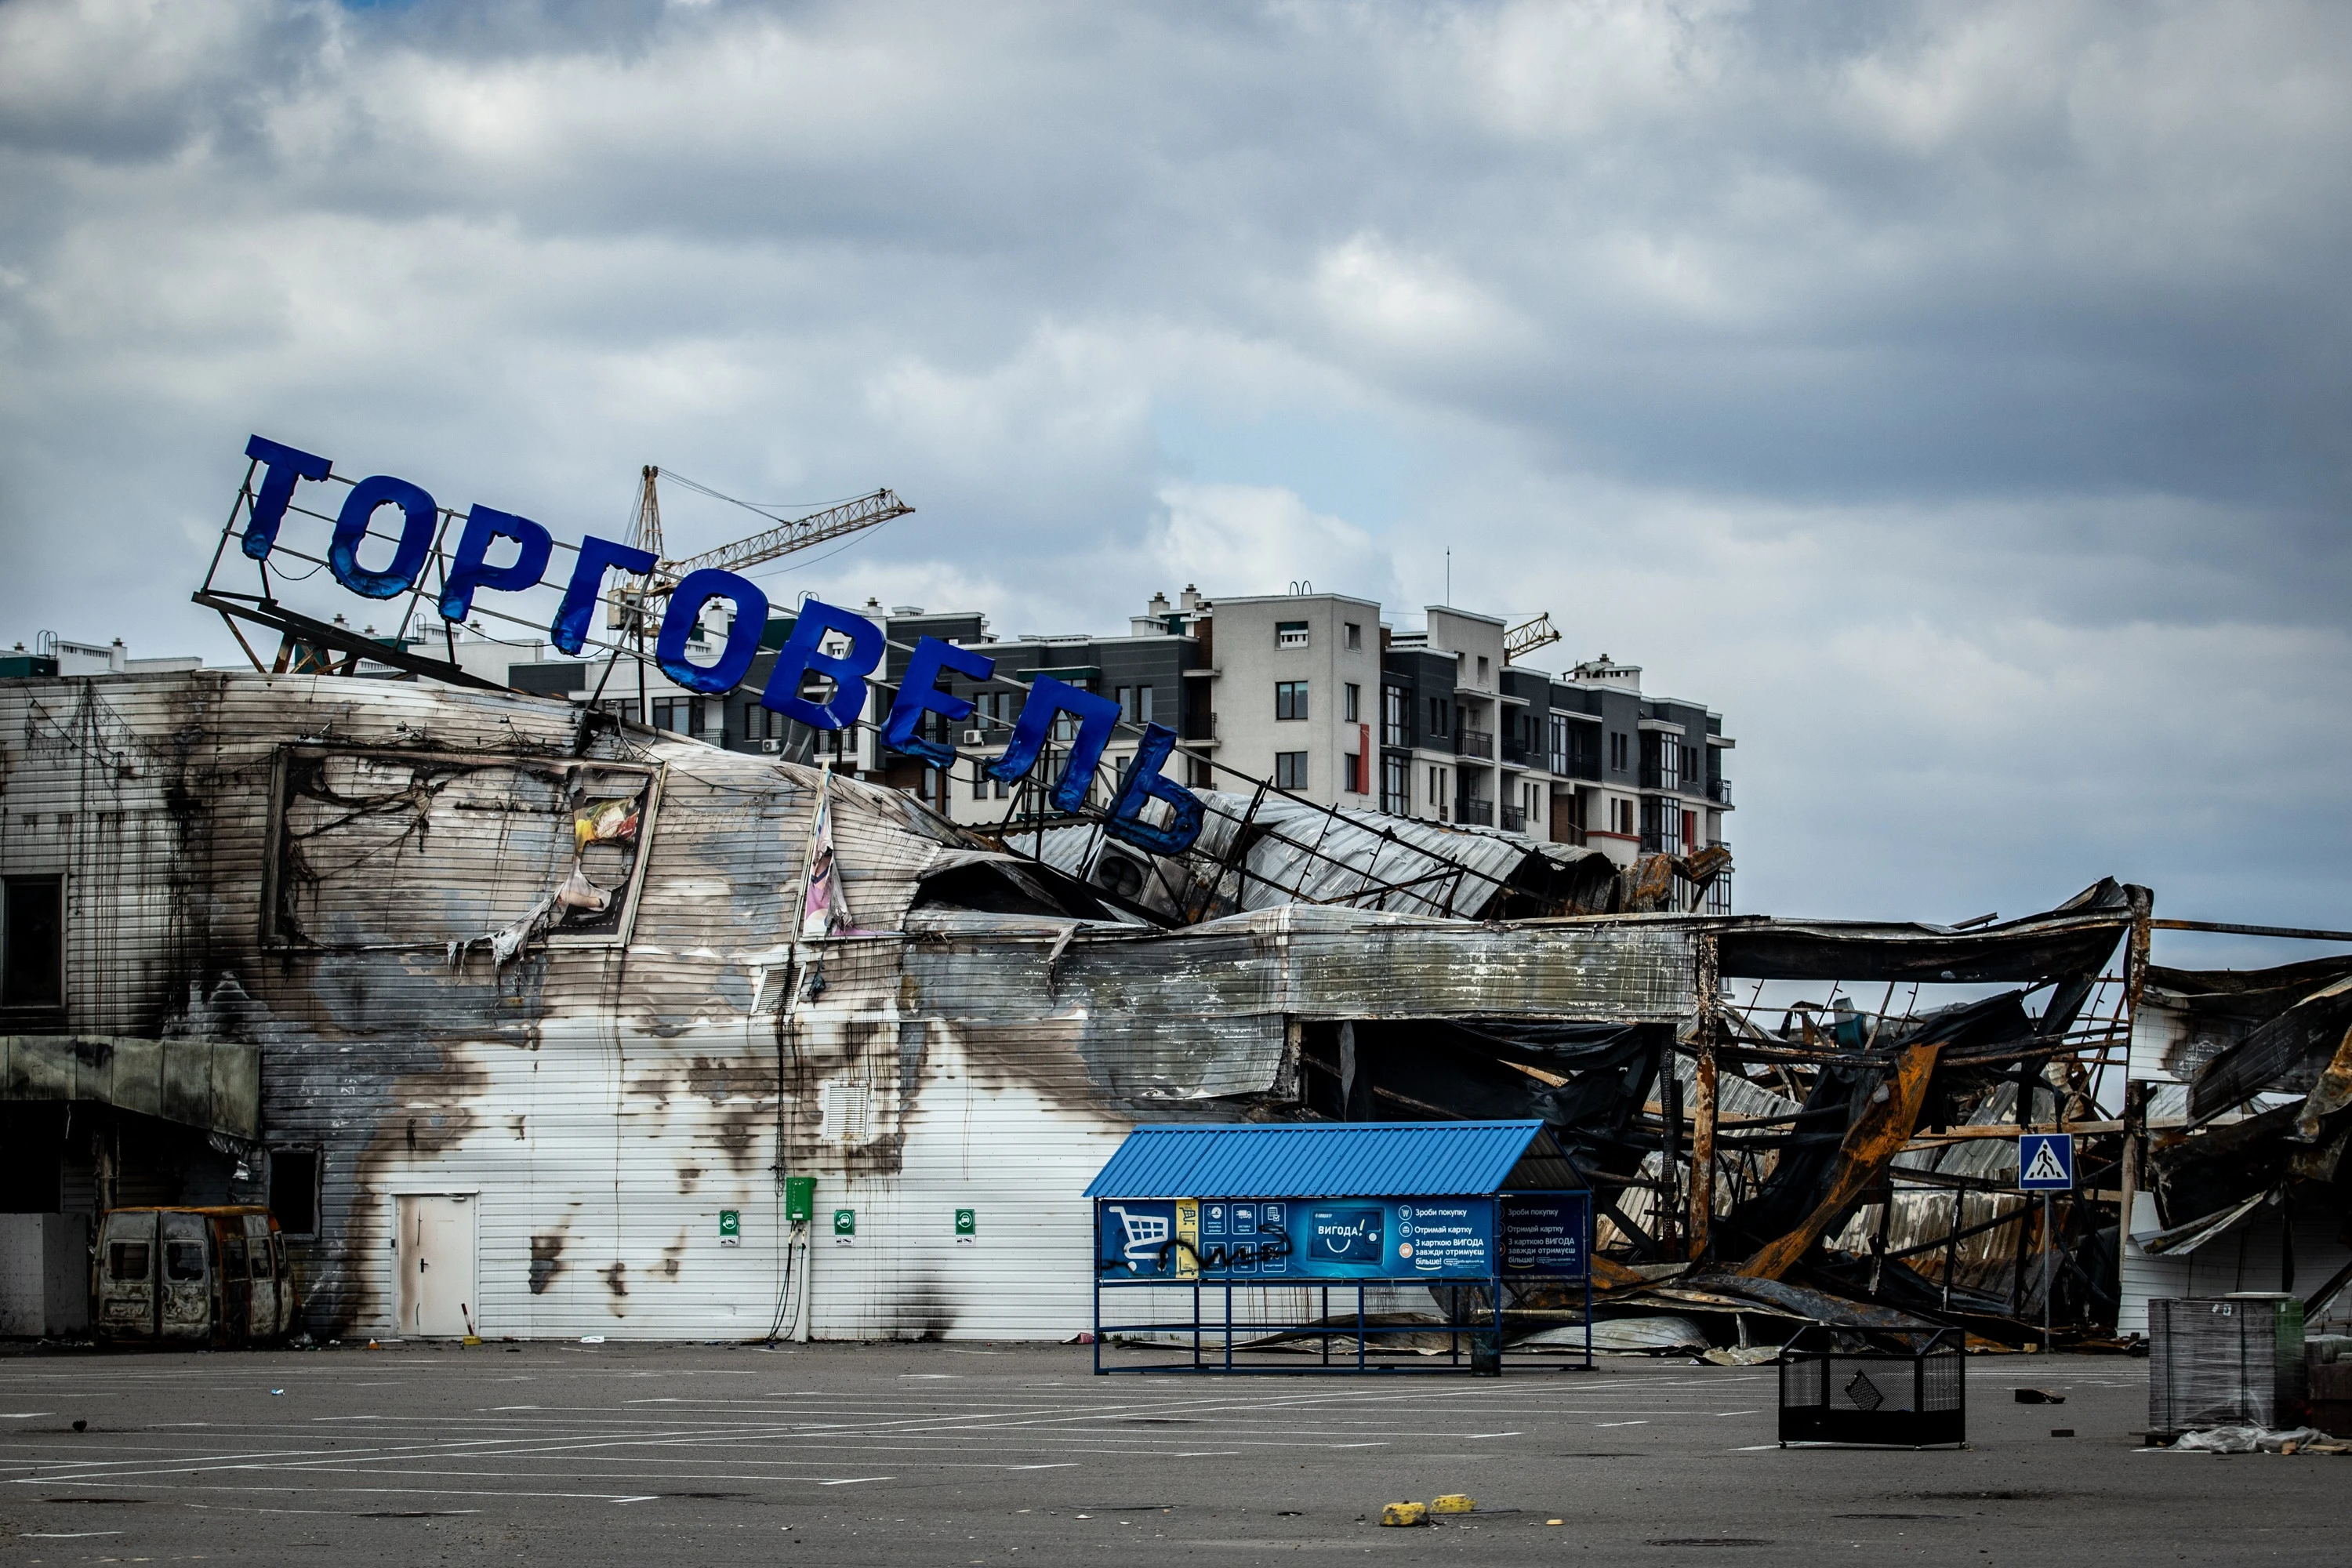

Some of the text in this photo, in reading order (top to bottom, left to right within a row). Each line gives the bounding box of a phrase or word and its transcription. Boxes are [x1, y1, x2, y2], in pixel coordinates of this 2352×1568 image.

[241, 434, 1206, 856] ТОРГОВЕЛЬ
[1415, 1209, 1436, 1218] Зроби
[1318, 1219, 1365, 1237] ВИГОДА!
[1414, 1225, 1446, 1235] Отримай
[1508, 1225, 1538, 1234] Отримай
[1454, 1239, 1483, 1247] ВИГОДА
[1545, 1237, 1574, 1246] ВИГОДА
